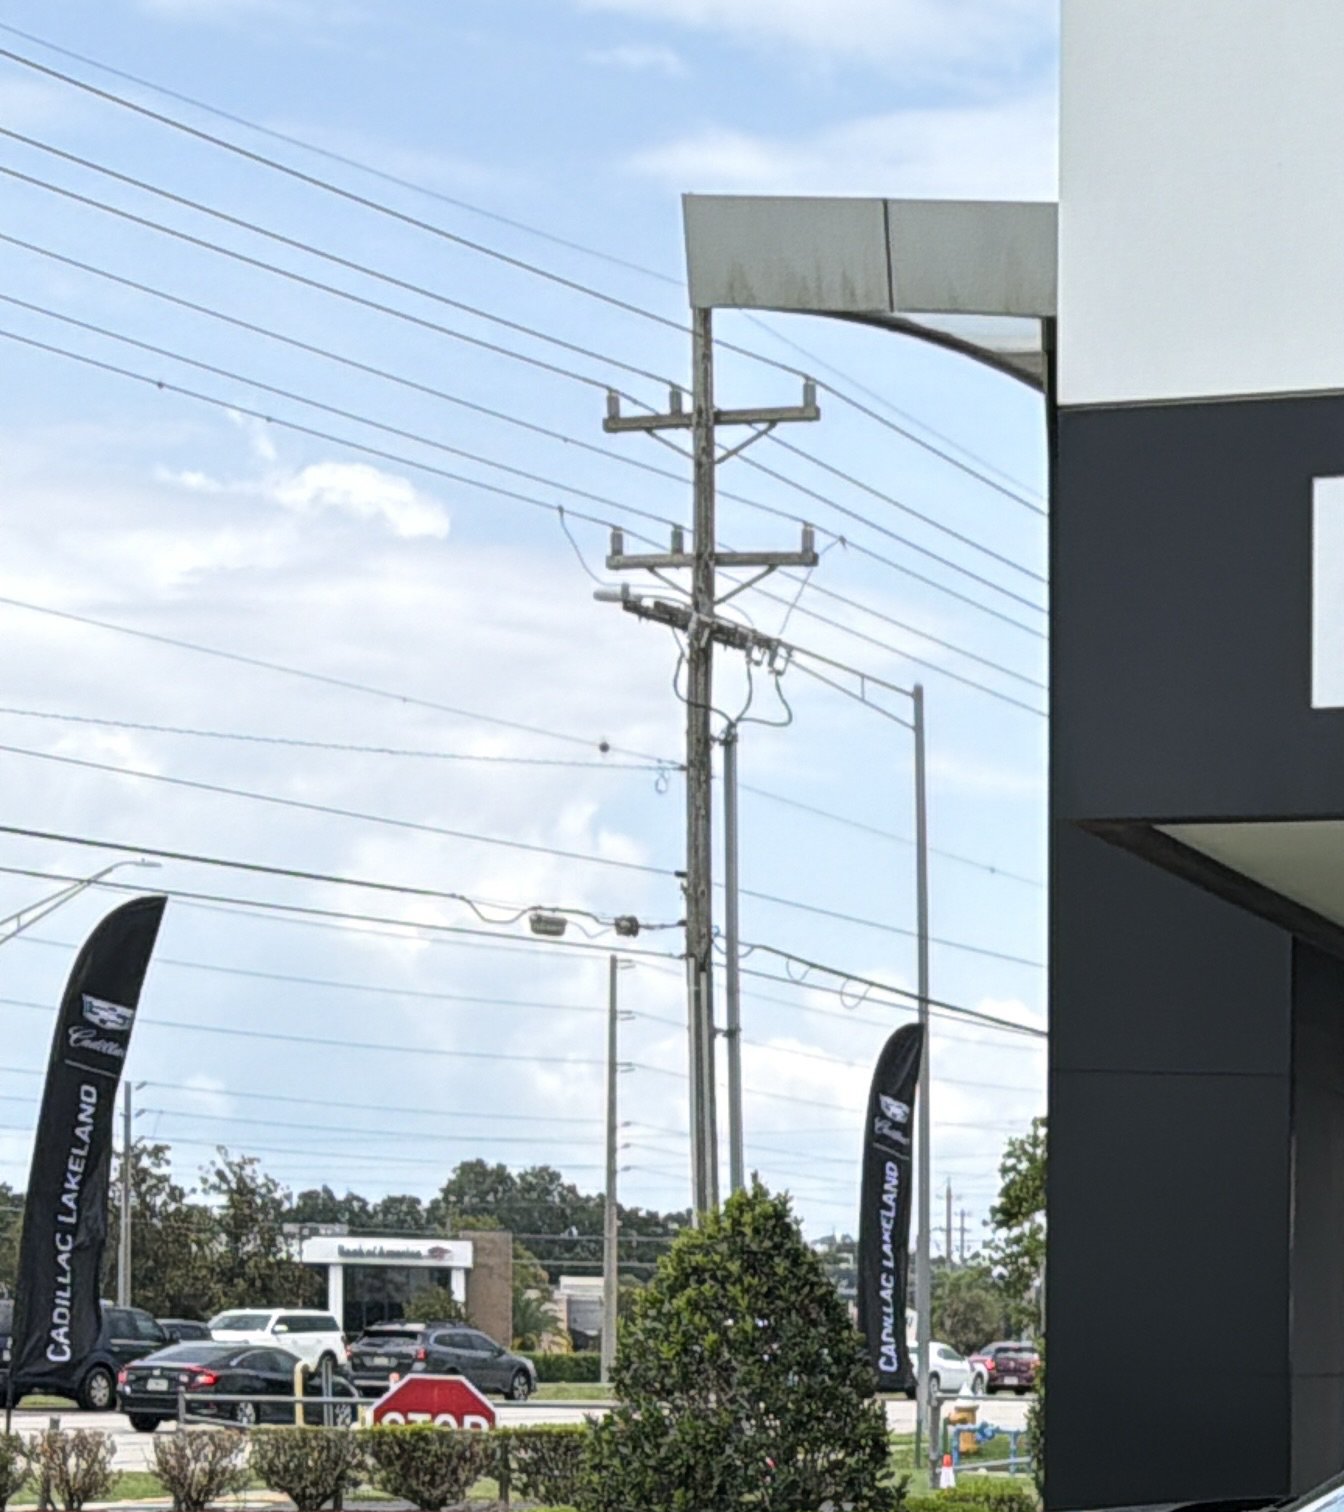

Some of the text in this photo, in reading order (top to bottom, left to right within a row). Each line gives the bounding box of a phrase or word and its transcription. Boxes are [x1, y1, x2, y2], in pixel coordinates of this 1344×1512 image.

[46, 1084, 98, 1363] CADILLAC LAKELAND
[879, 1160, 900, 1270] LAKELAND
[878, 1272, 898, 1373] CADILLAC
